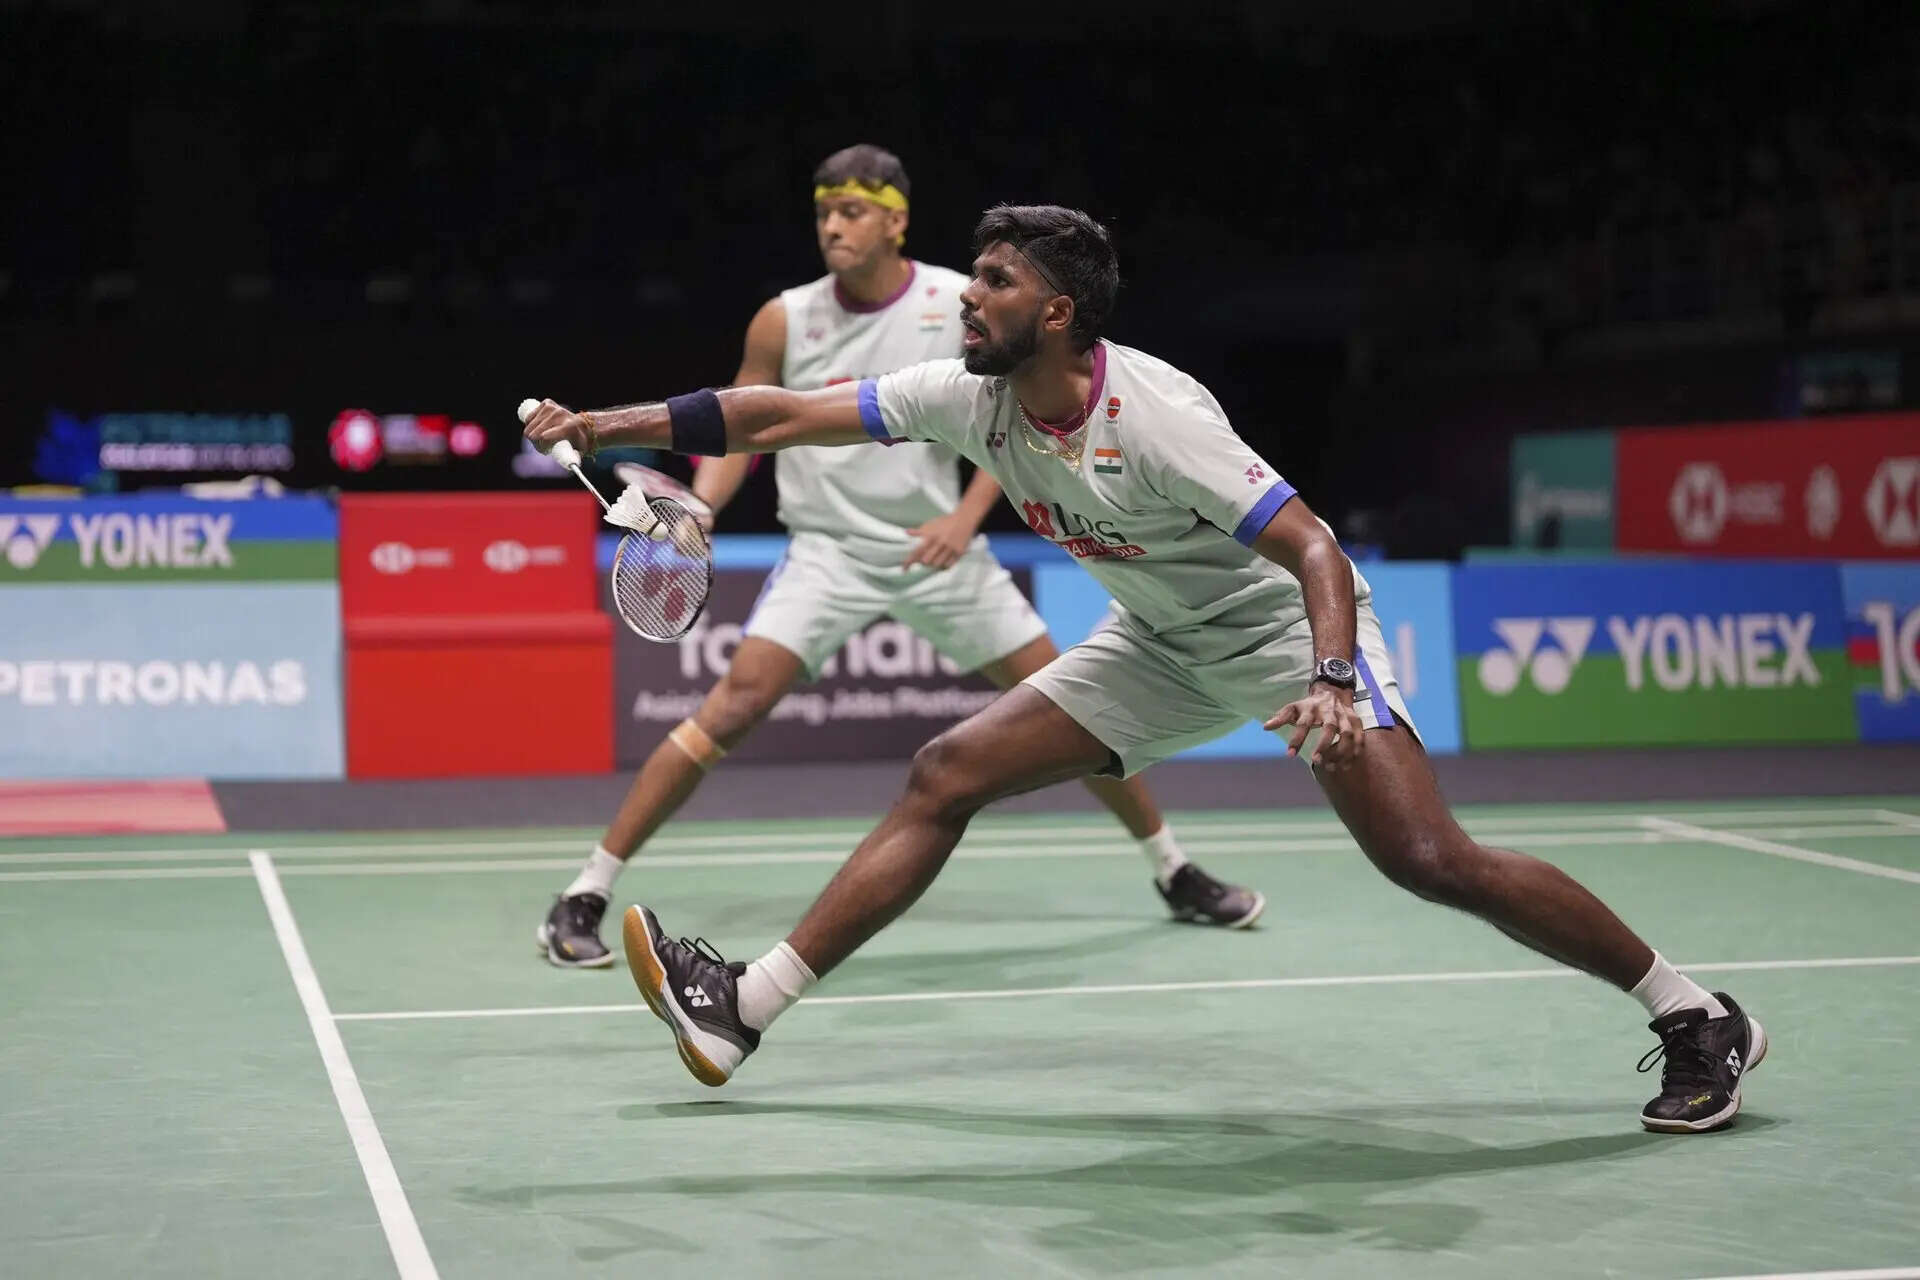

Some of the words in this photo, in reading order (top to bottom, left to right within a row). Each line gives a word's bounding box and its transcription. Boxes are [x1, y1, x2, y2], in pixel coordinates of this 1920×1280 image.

[70, 513, 234, 570] YONEX
[1608, 612, 1821, 691] YONEX
[0, 659, 307, 706] PETRONAS
